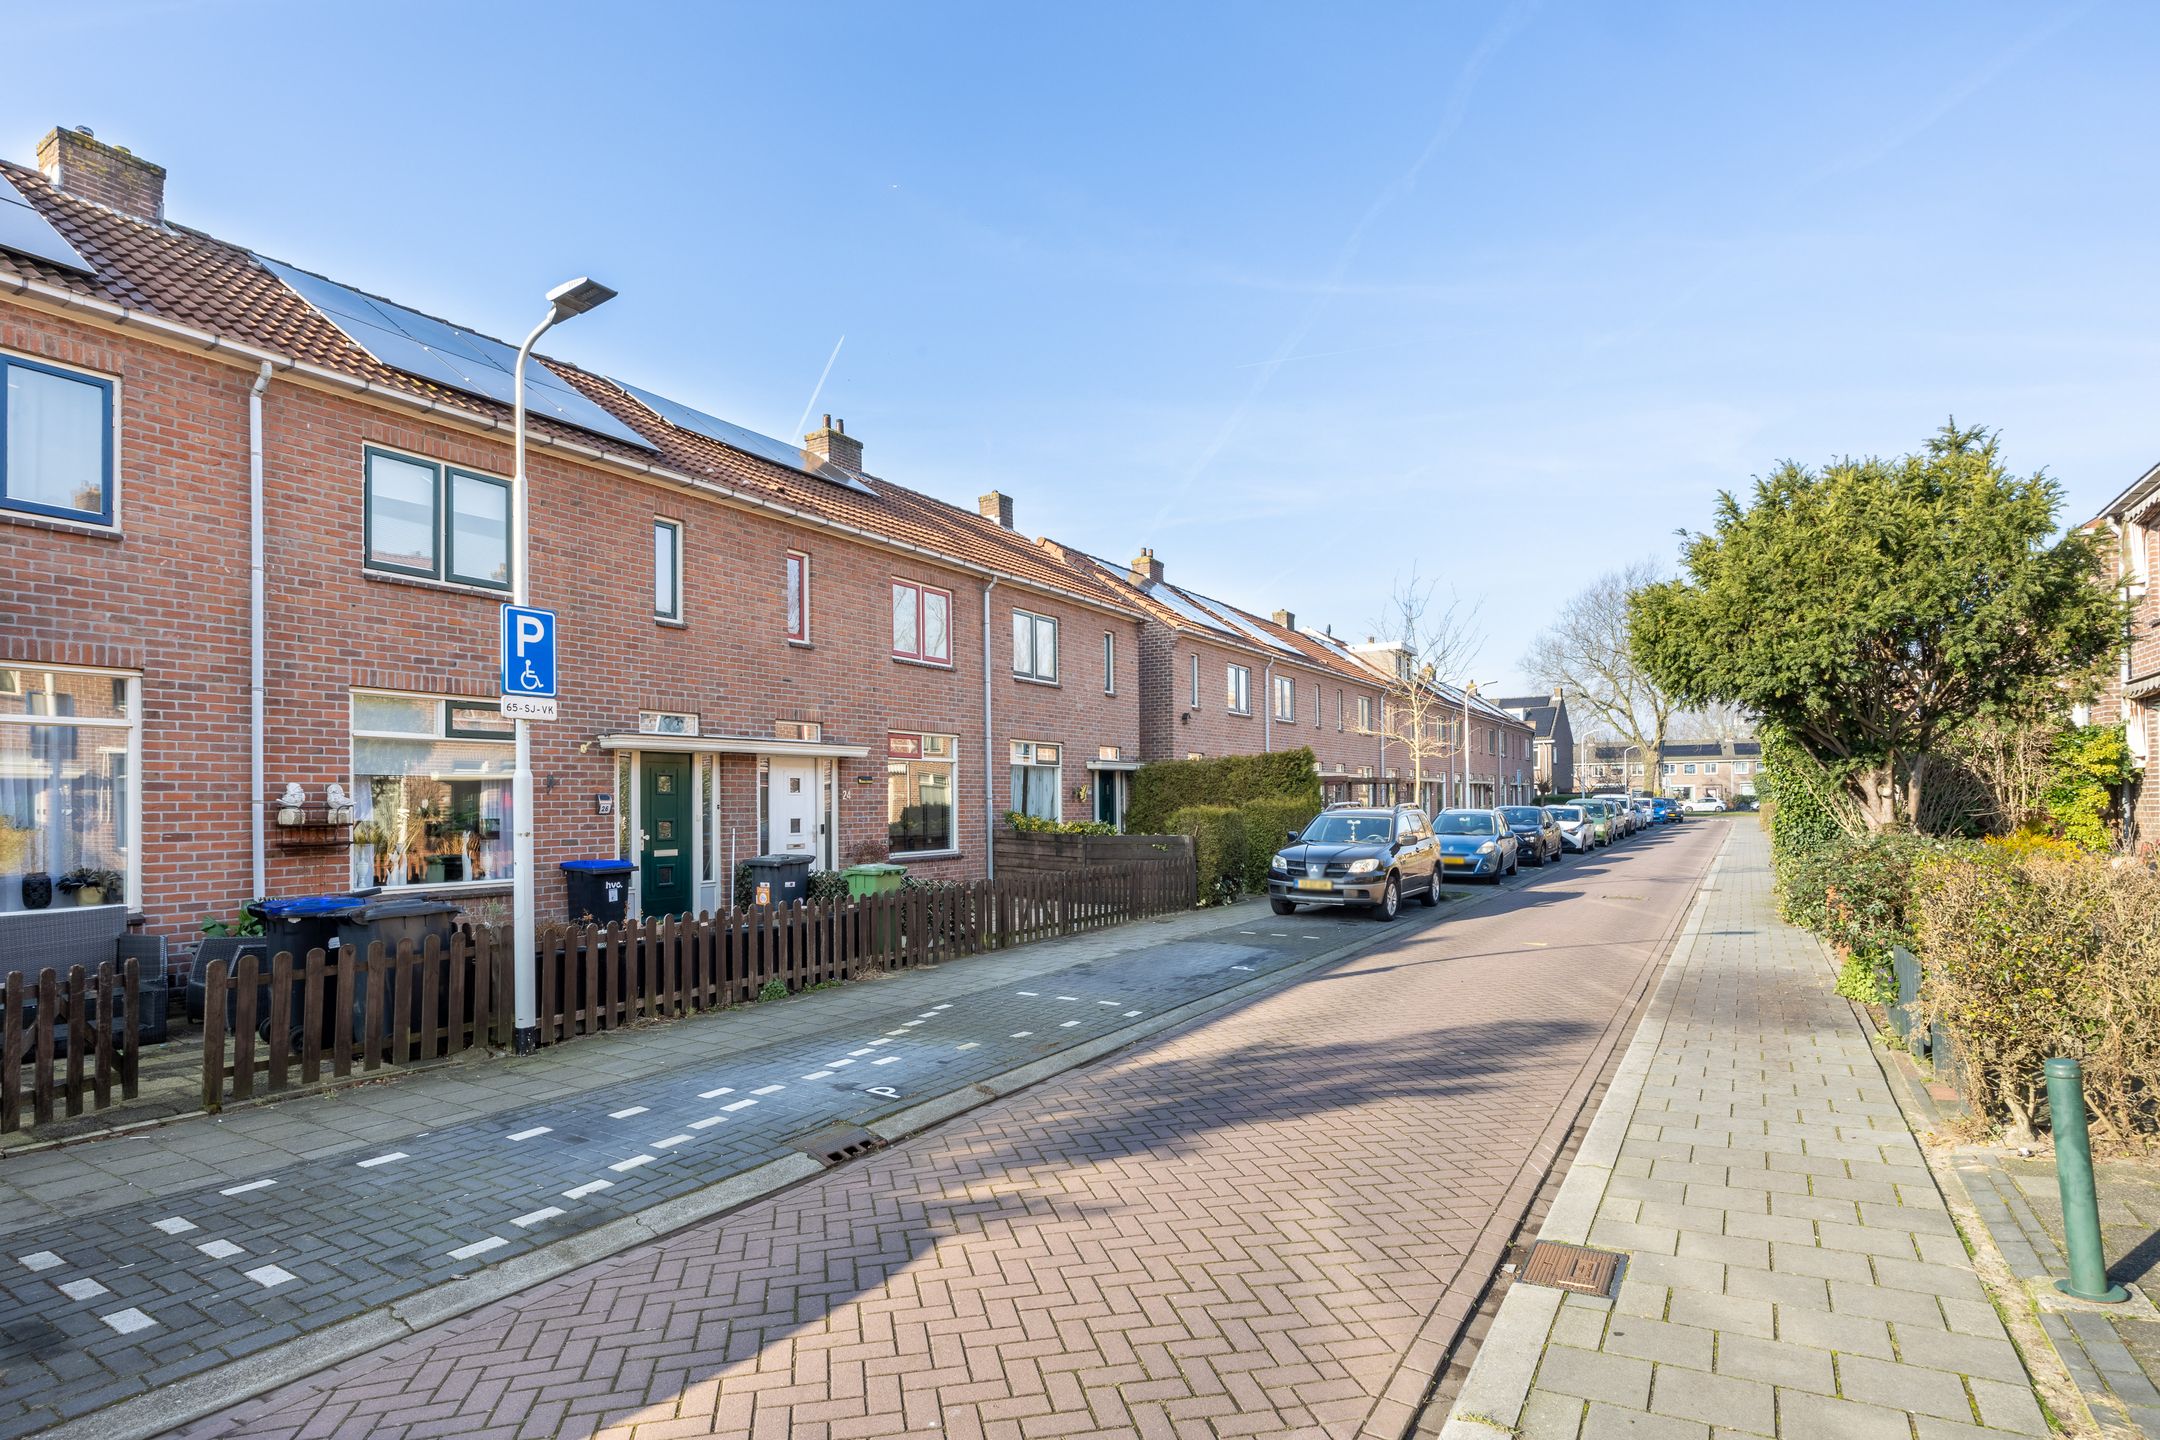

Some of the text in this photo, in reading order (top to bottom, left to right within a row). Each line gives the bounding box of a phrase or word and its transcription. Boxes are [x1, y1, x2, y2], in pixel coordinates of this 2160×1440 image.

[517, 614, 544, 657] P
[506, 703, 554, 714] 65-SJ-VK
[842, 790, 851, 800] 24
[865, 1086, 901, 1099] P
